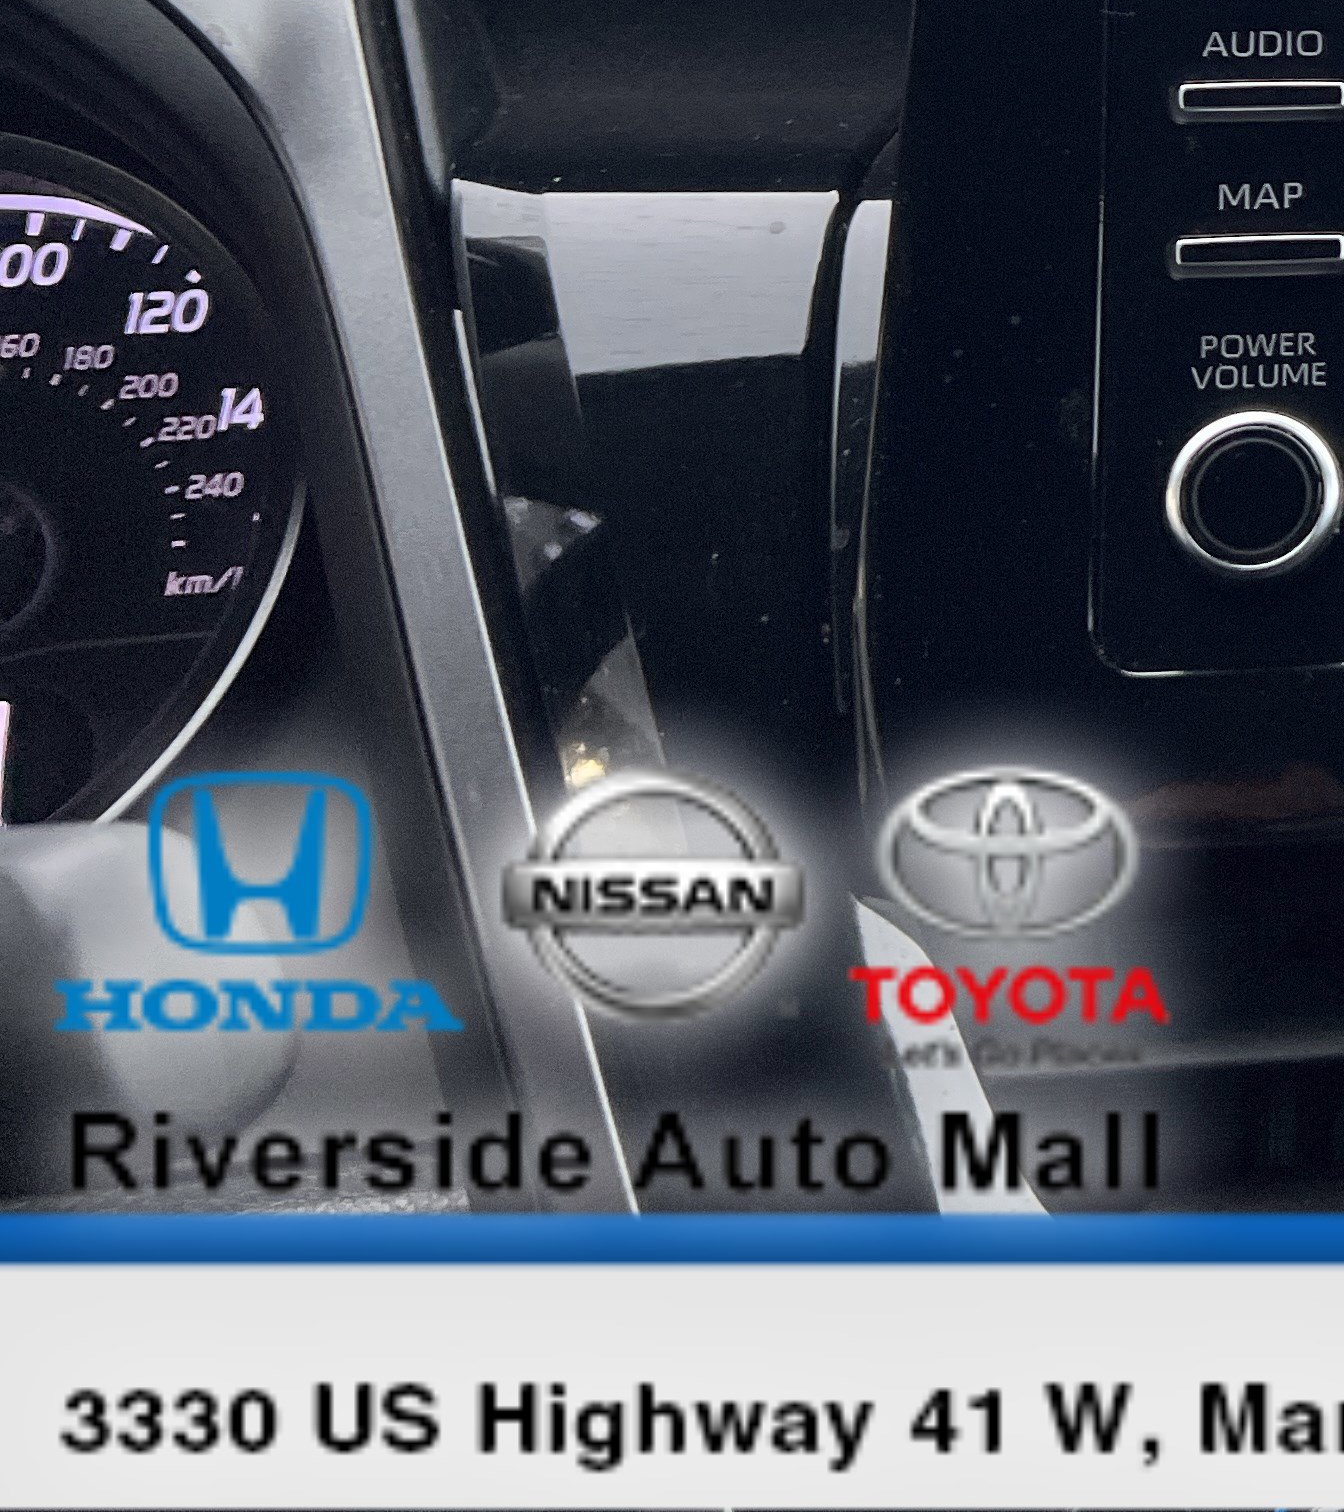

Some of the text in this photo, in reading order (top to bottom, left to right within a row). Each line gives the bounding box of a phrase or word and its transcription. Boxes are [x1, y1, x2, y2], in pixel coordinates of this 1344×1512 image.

[1202, 29, 1325, 58] AUDIO
[1217, 181, 1304, 211] MAP
[0, 242, 69, 288] 00
[124, 288, 210, 335] 120
[0, 332, 42, 359] 60
[63, 344, 116, 372] 180
[1199, 332, 1317, 359] POWER
[119, 372, 180, 400] 200
[1190, 362, 1327, 390] VOLUME
[216, 387, 265, 432] 14
[157, 414, 217, 442] 220
[184, 471, 246, 500] 240
